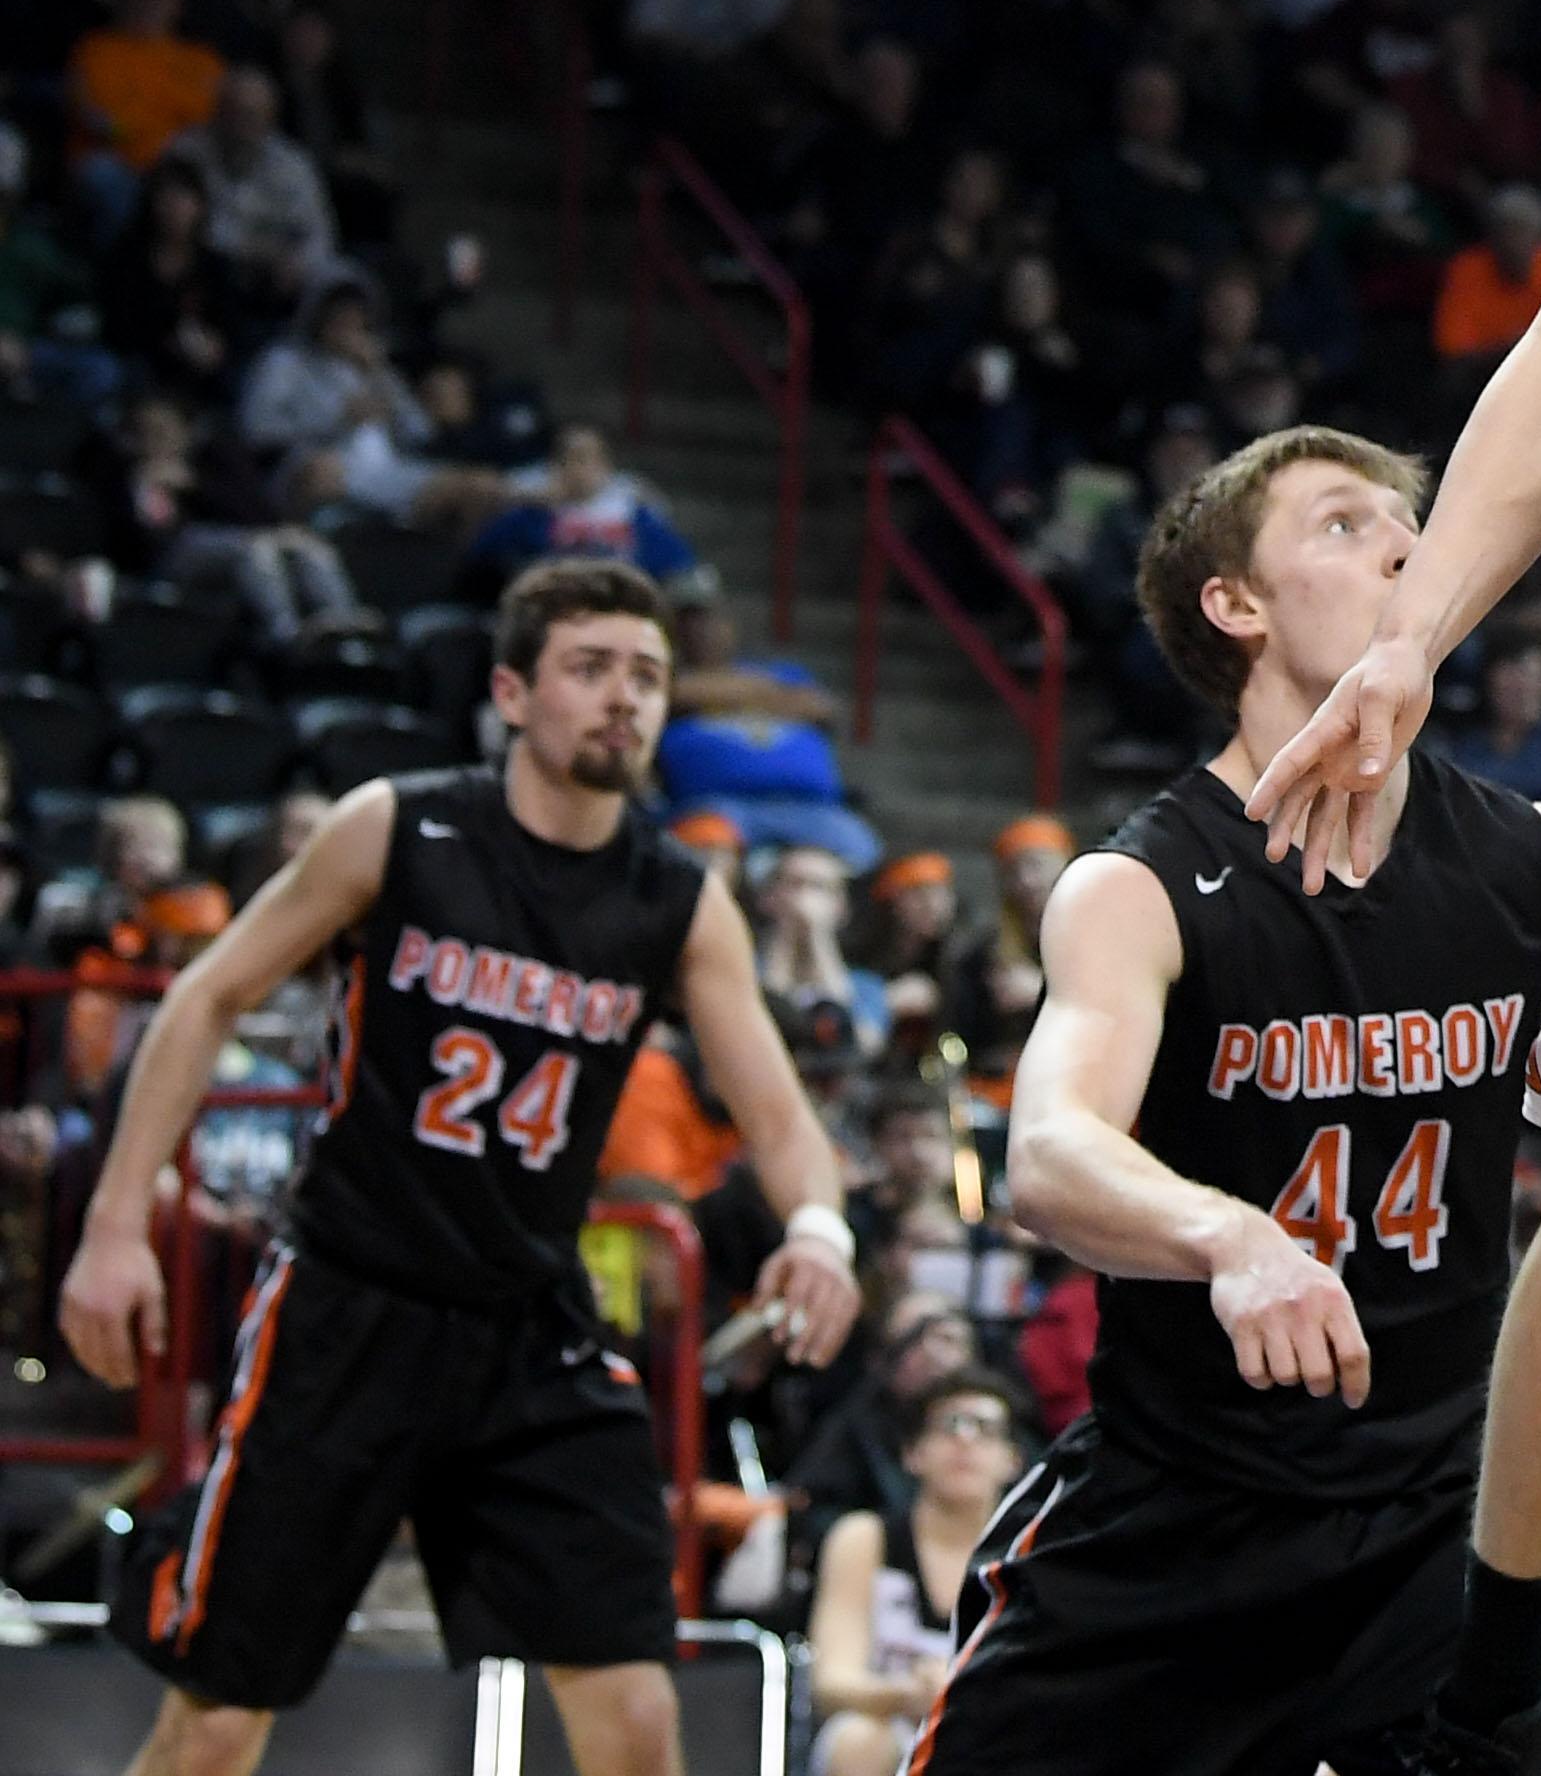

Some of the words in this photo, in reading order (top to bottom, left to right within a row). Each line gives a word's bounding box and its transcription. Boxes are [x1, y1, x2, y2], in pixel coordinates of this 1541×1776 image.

[388, 926, 646, 1045] POMEROY
[1206, 993, 1526, 1101] POMEROY
[413, 1026, 581, 1172] 24
[1270, 1119, 1452, 1273] 44
